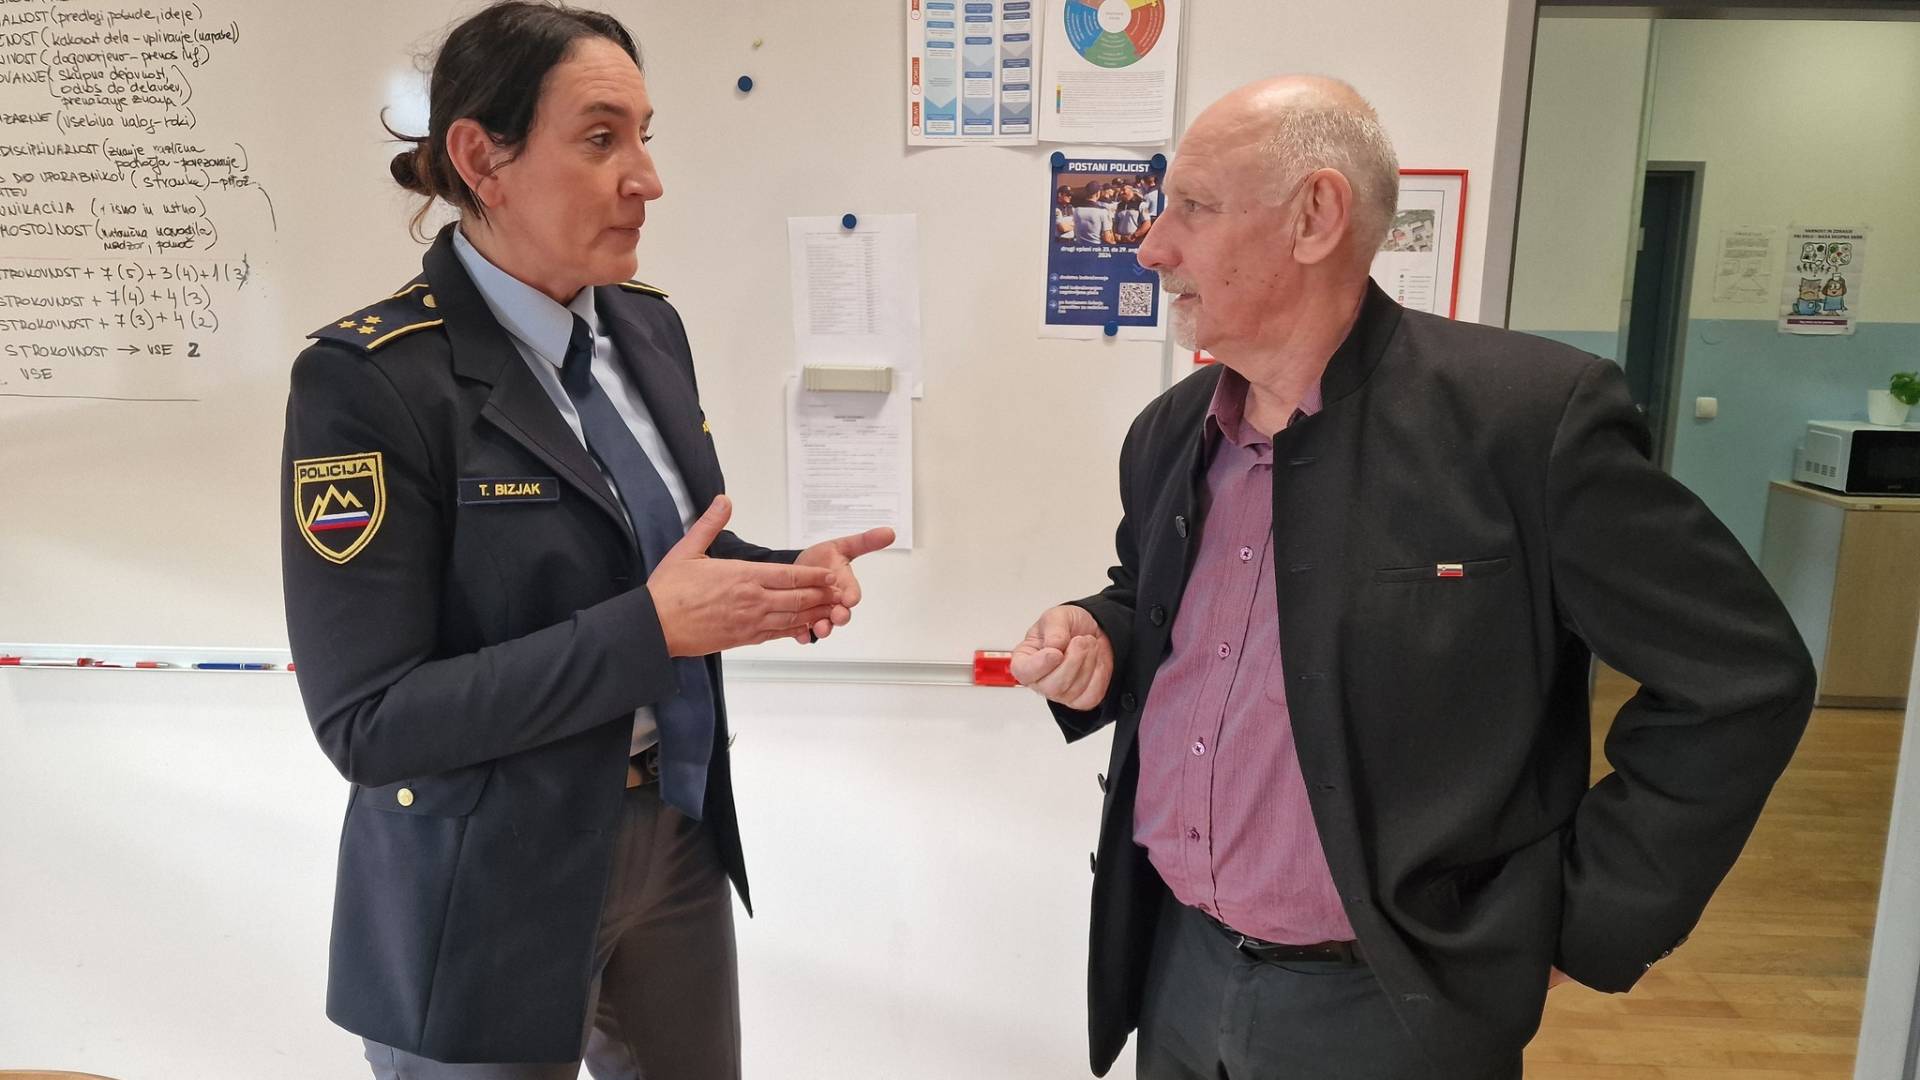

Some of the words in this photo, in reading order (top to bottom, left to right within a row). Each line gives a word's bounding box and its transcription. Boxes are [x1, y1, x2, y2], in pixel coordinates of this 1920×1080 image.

[108, 82, 125, 94] do
[1068, 161, 1108, 172] POSTANI
[1109, 163, 1151, 173] POLICIST
[0, 265, 81, 280] TROKOVNOST
[5, 343, 109, 358] STROKOVNOST
[147, 344, 174, 356] VSE
[20, 367, 53, 380] VSE
[299, 461, 372, 480] POLICIJA
[479, 483, 491, 497] T.
[494, 482, 542, 497] BIZJAK
